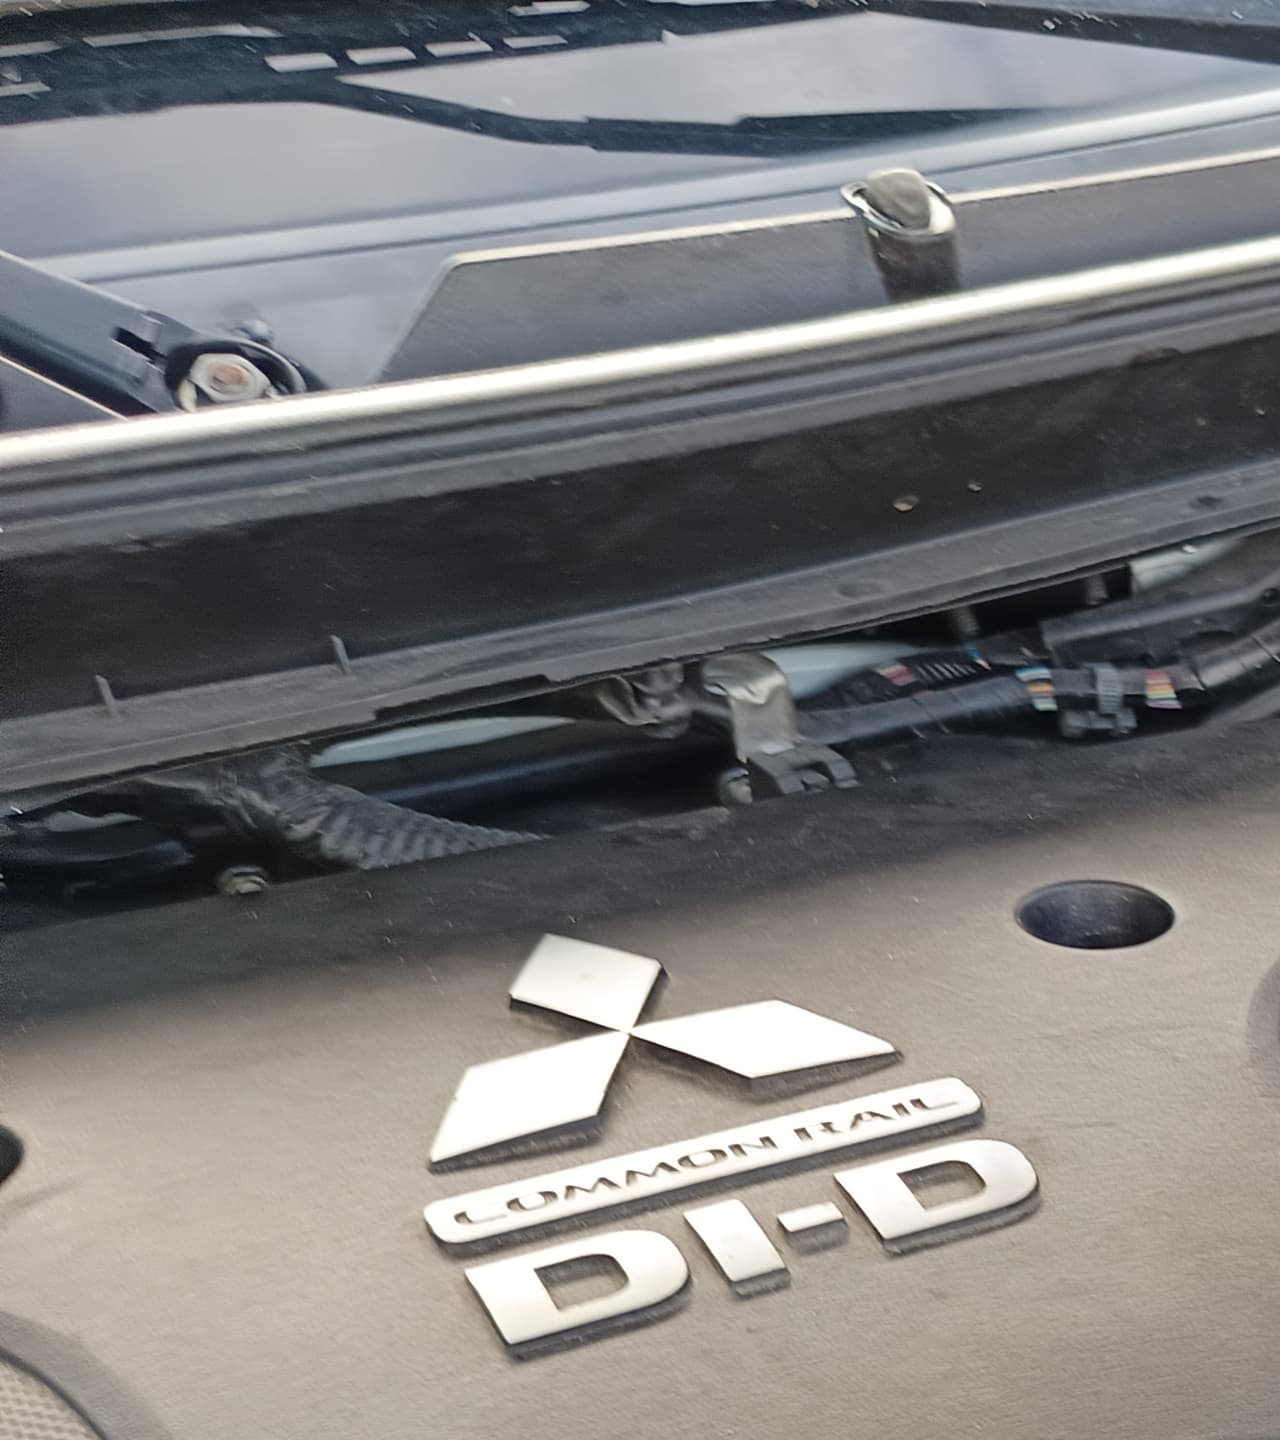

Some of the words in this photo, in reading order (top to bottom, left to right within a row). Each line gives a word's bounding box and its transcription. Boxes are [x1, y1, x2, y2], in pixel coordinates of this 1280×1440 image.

[453, 1133, 779, 1226] COMMON
[792, 1093, 960, 1144] RAIL
[464, 1139, 1040, 1346] DI-D
